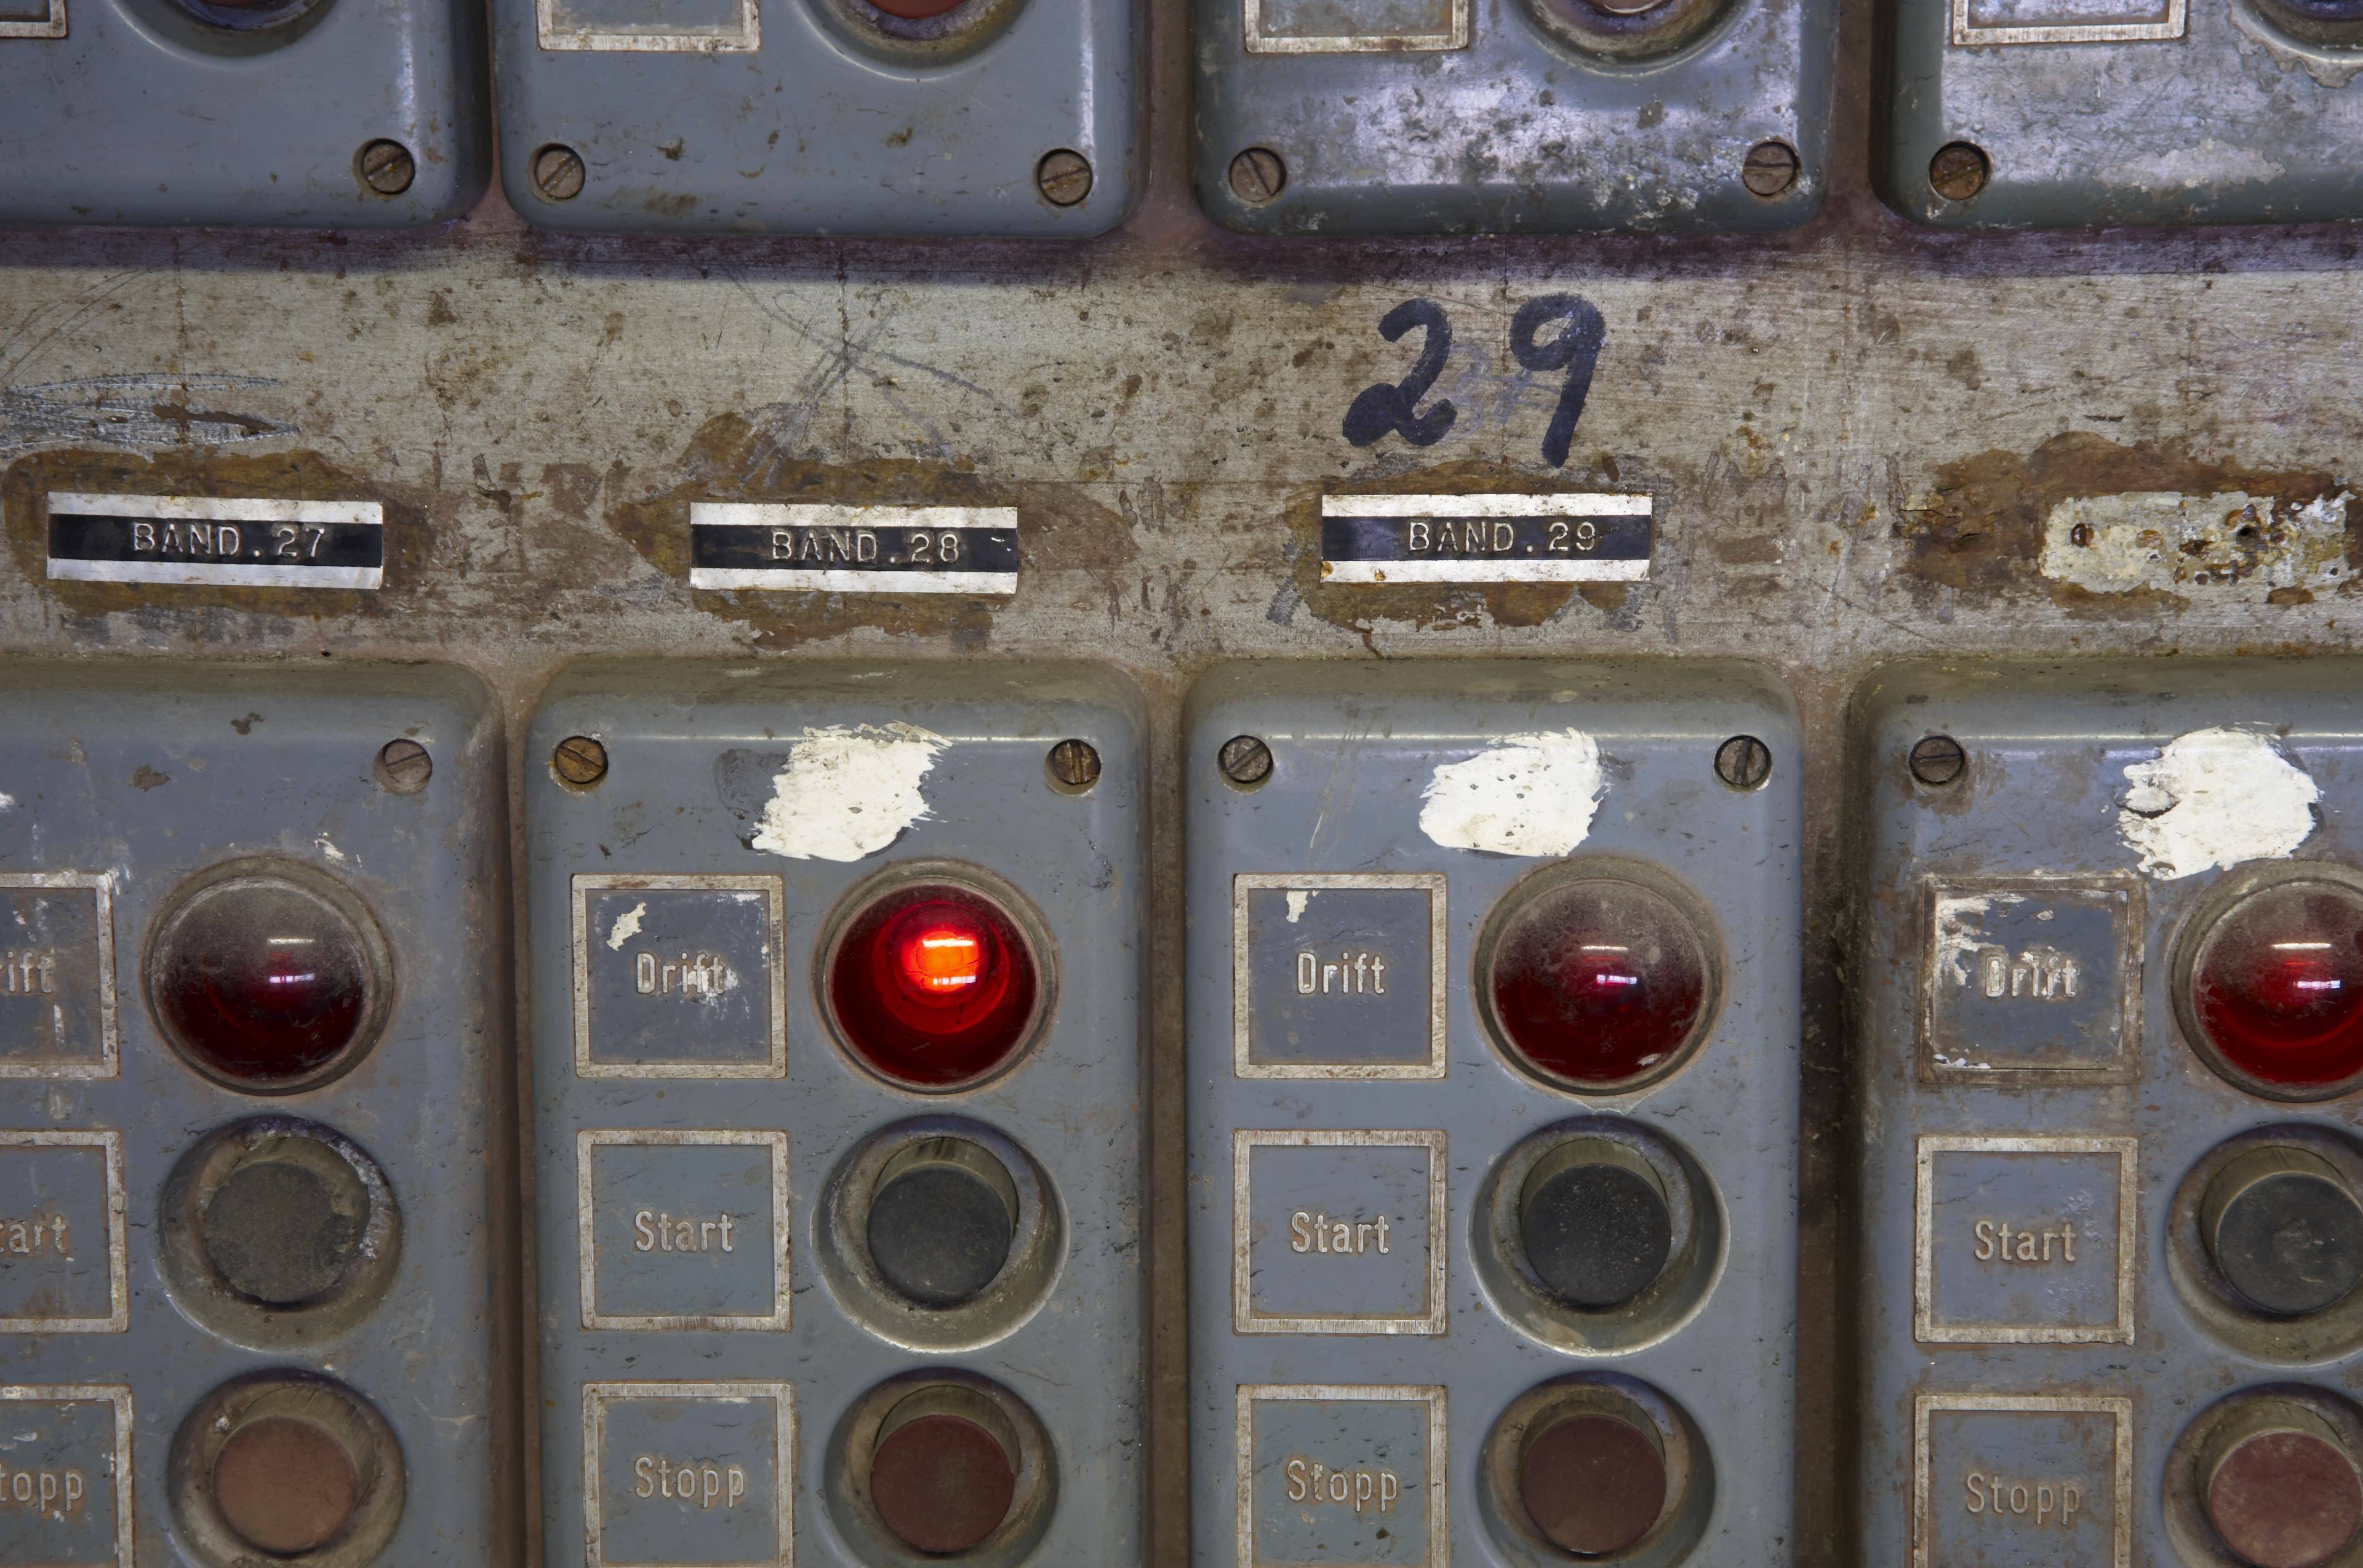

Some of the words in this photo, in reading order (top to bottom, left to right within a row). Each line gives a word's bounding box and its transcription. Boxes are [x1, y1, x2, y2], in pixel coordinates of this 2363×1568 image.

[1343, 291, 1606, 469] 29
[131, 521, 326, 559] BAND.27
[771, 530, 959, 564] BAND.28
[1407, 520, 1597, 554] BAND.29
[0, 951, 53, 993] ift
[637, 952, 724, 994] Drift
[1298, 952, 1385, 994] Drift
[1985, 956, 2078, 997] Drift
[635, 1210, 733, 1252] Start
[1291, 1212, 1389, 1253] Start
[1974, 1220, 2077, 1262] Start
[635, 1457, 744, 1508] Stopp
[1288, 1460, 1397, 1511] Stopp
[1967, 1472, 2080, 1525] Stopp
